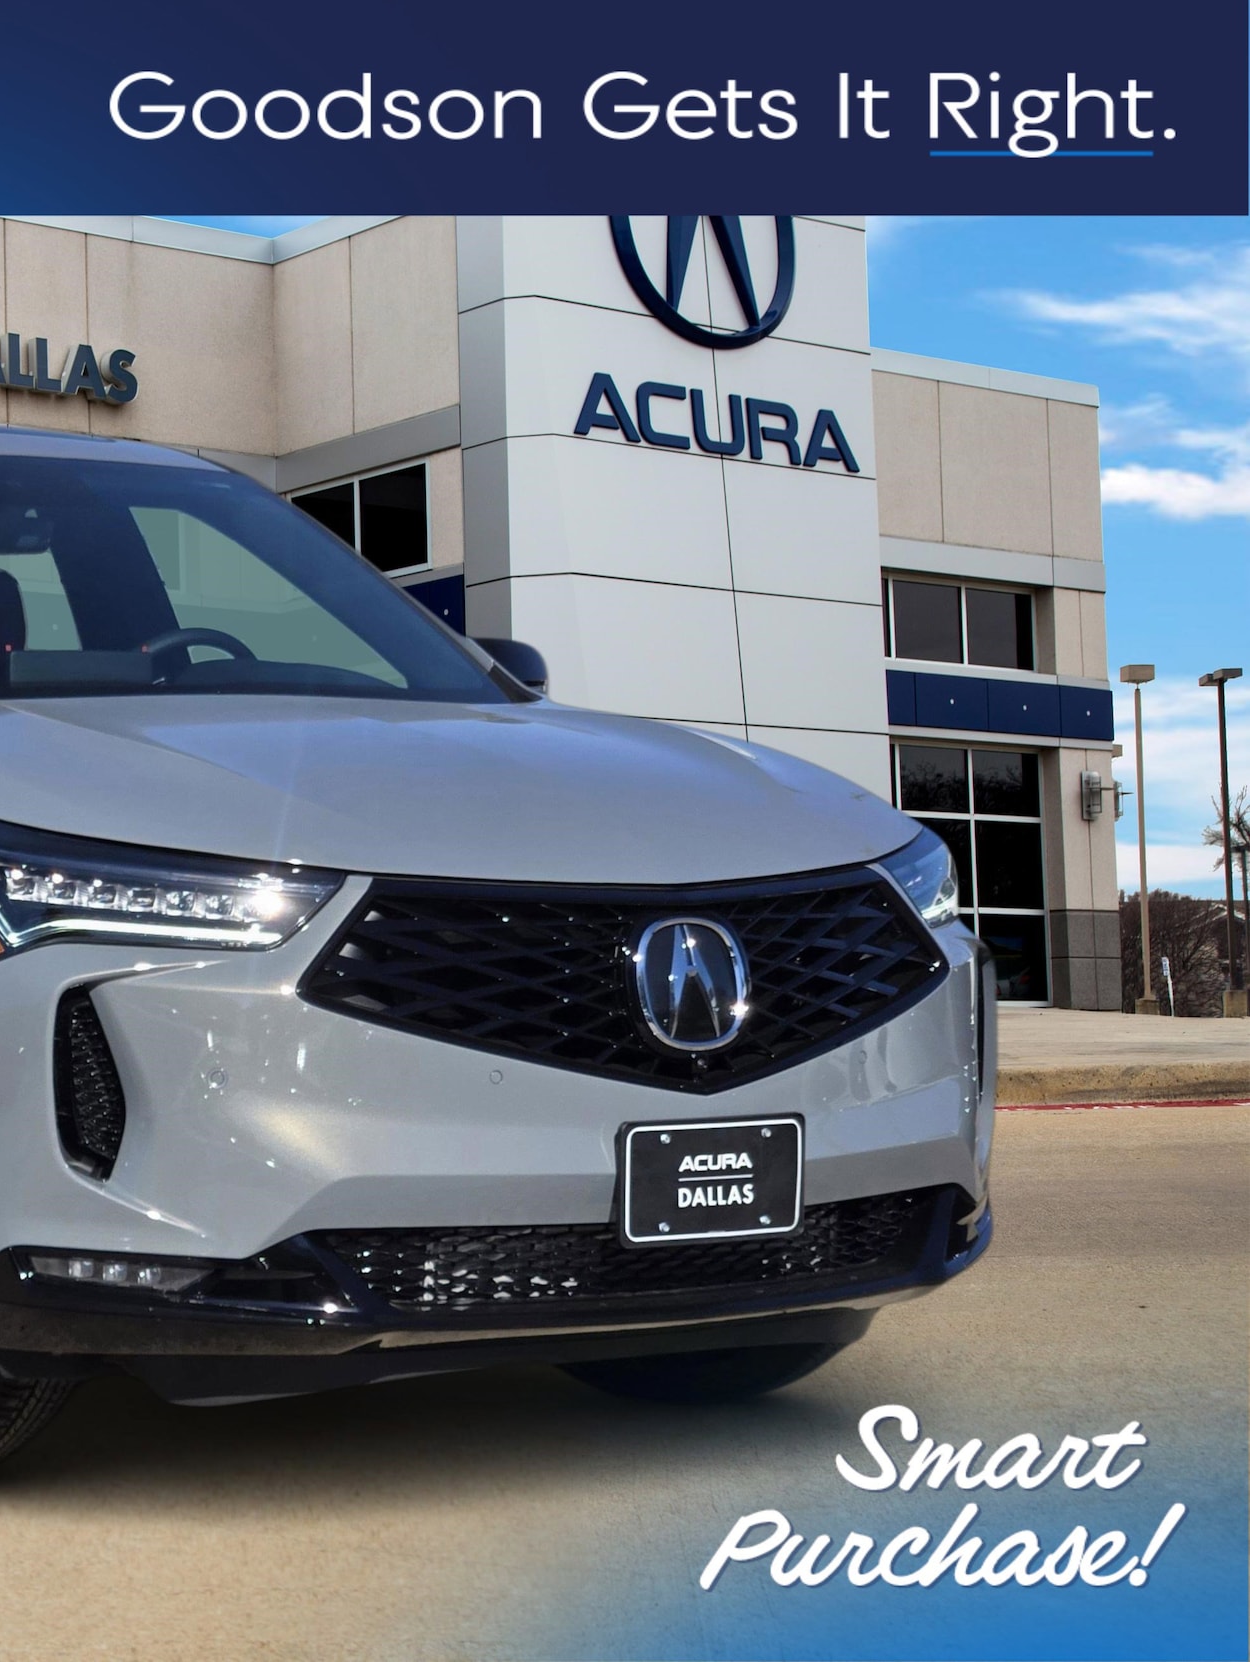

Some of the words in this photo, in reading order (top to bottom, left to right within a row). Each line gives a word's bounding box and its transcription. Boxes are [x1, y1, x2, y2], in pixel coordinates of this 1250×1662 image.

[573, 372, 860, 473] ACURA
[678, 1152, 753, 1173] ACURA
[677, 1183, 754, 1208] DALLAS
